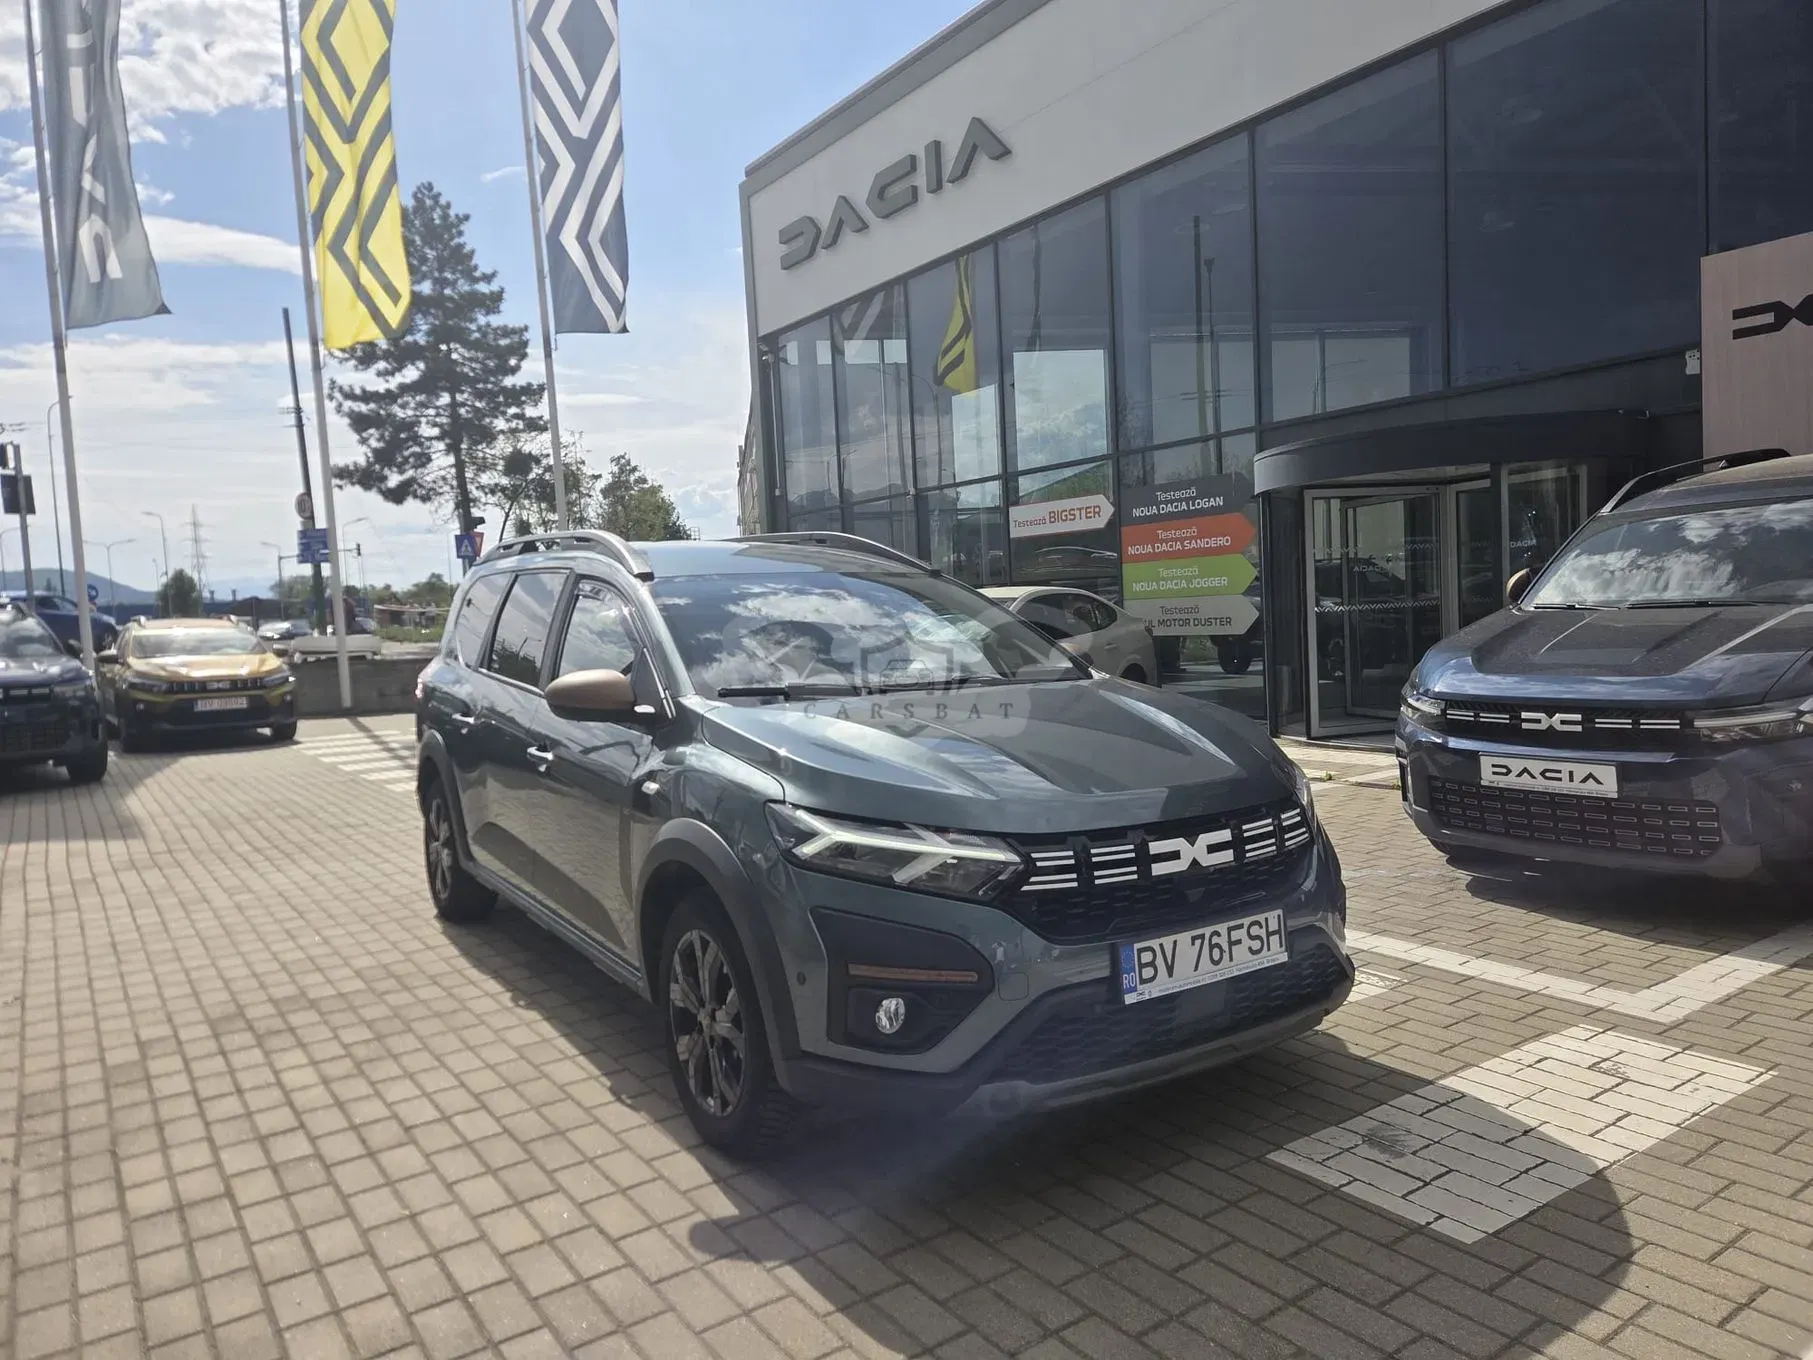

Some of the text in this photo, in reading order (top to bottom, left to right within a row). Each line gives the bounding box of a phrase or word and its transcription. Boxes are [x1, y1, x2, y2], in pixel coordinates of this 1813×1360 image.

[779, 116, 1012, 270] DACIA
[1156, 487, 1196, 501] Testează
[1048, 504, 1102, 524] BIGSTER
[1132, 496, 1224, 517] NOUA DACIA LOGAN
[1157, 527, 1198, 539] Testează
[1128, 536, 1231, 555] NOUA DACIA SANDERO
[1158, 566, 1199, 578] Testează
[1132, 577, 1228, 592] NOUA DACIA JOGGER
[1160, 605, 1200, 615] Testează
[1157, 618, 1190, 628] MOTOR
[1193, 616, 1232, 627] DUSTER
[1491, 763, 1605, 786] DACIA
[1136, 939, 1178, 986] BV
[1190, 913, 1284, 973] 76FSH
[1122, 973, 1136, 990] RO
